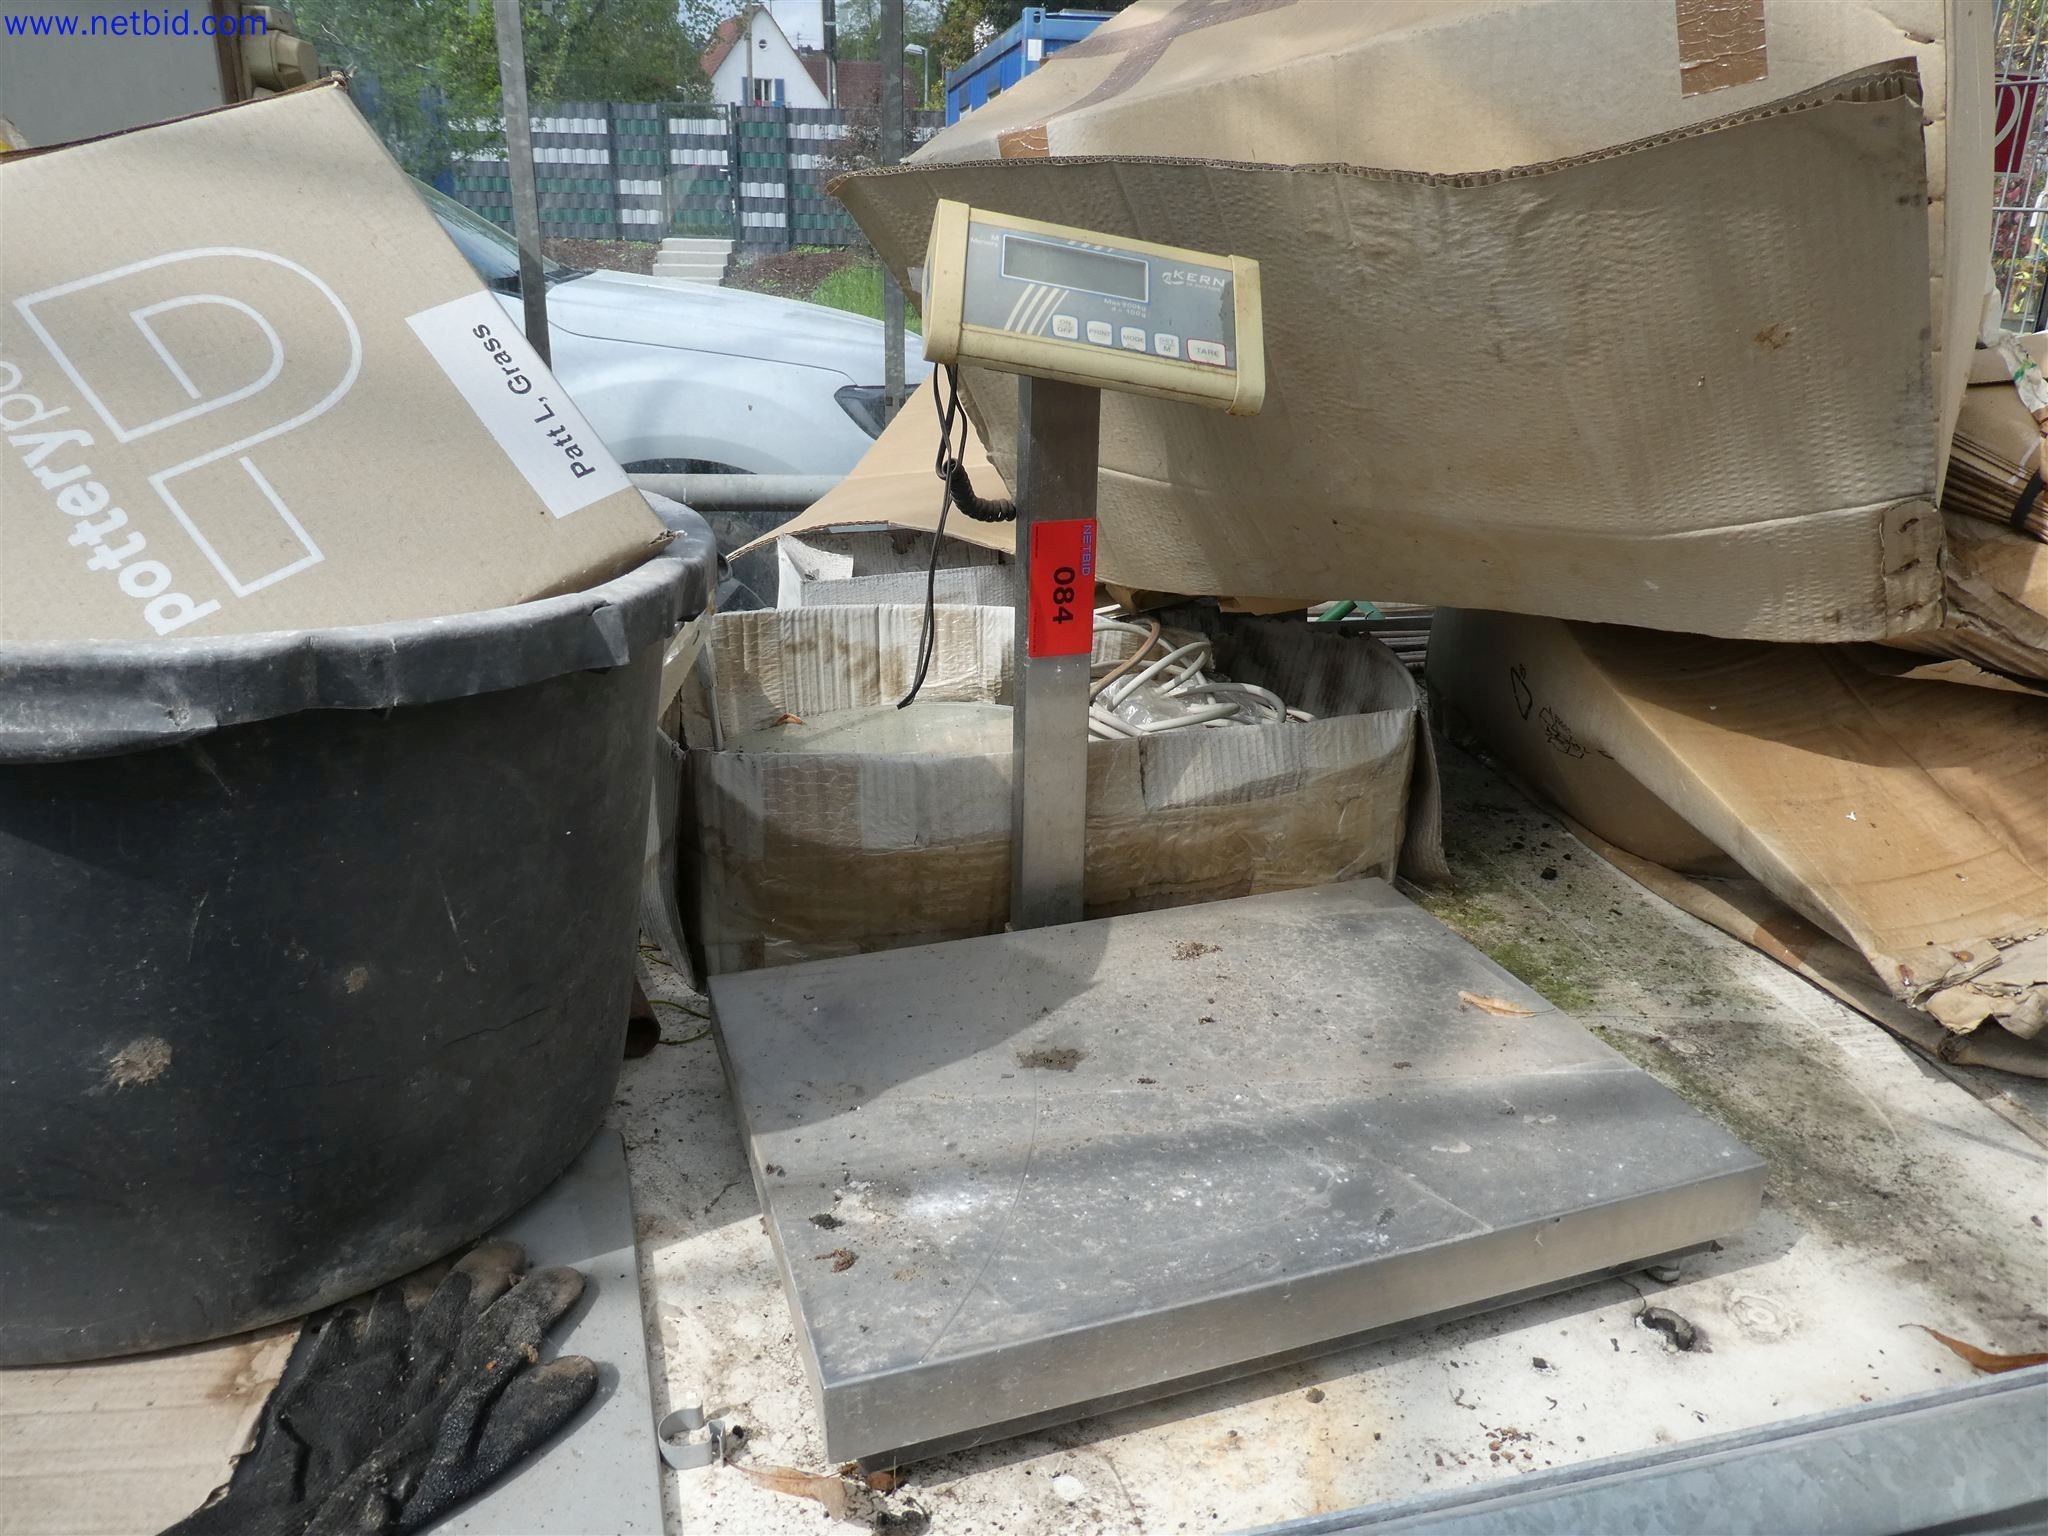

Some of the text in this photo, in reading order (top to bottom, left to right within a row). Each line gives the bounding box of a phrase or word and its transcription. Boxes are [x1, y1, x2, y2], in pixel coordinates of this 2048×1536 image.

[1173, 269, 1225, 288] KERN
[1088, 327, 1112, 337] PRINT
[1123, 334, 1144, 344] MODE
[1196, 346, 1220, 358] TARE
[472, 324, 596, 479] Patt L, Grass
[1082, 525, 1092, 576] NETBID
[1053, 567, 1075, 624] 084
